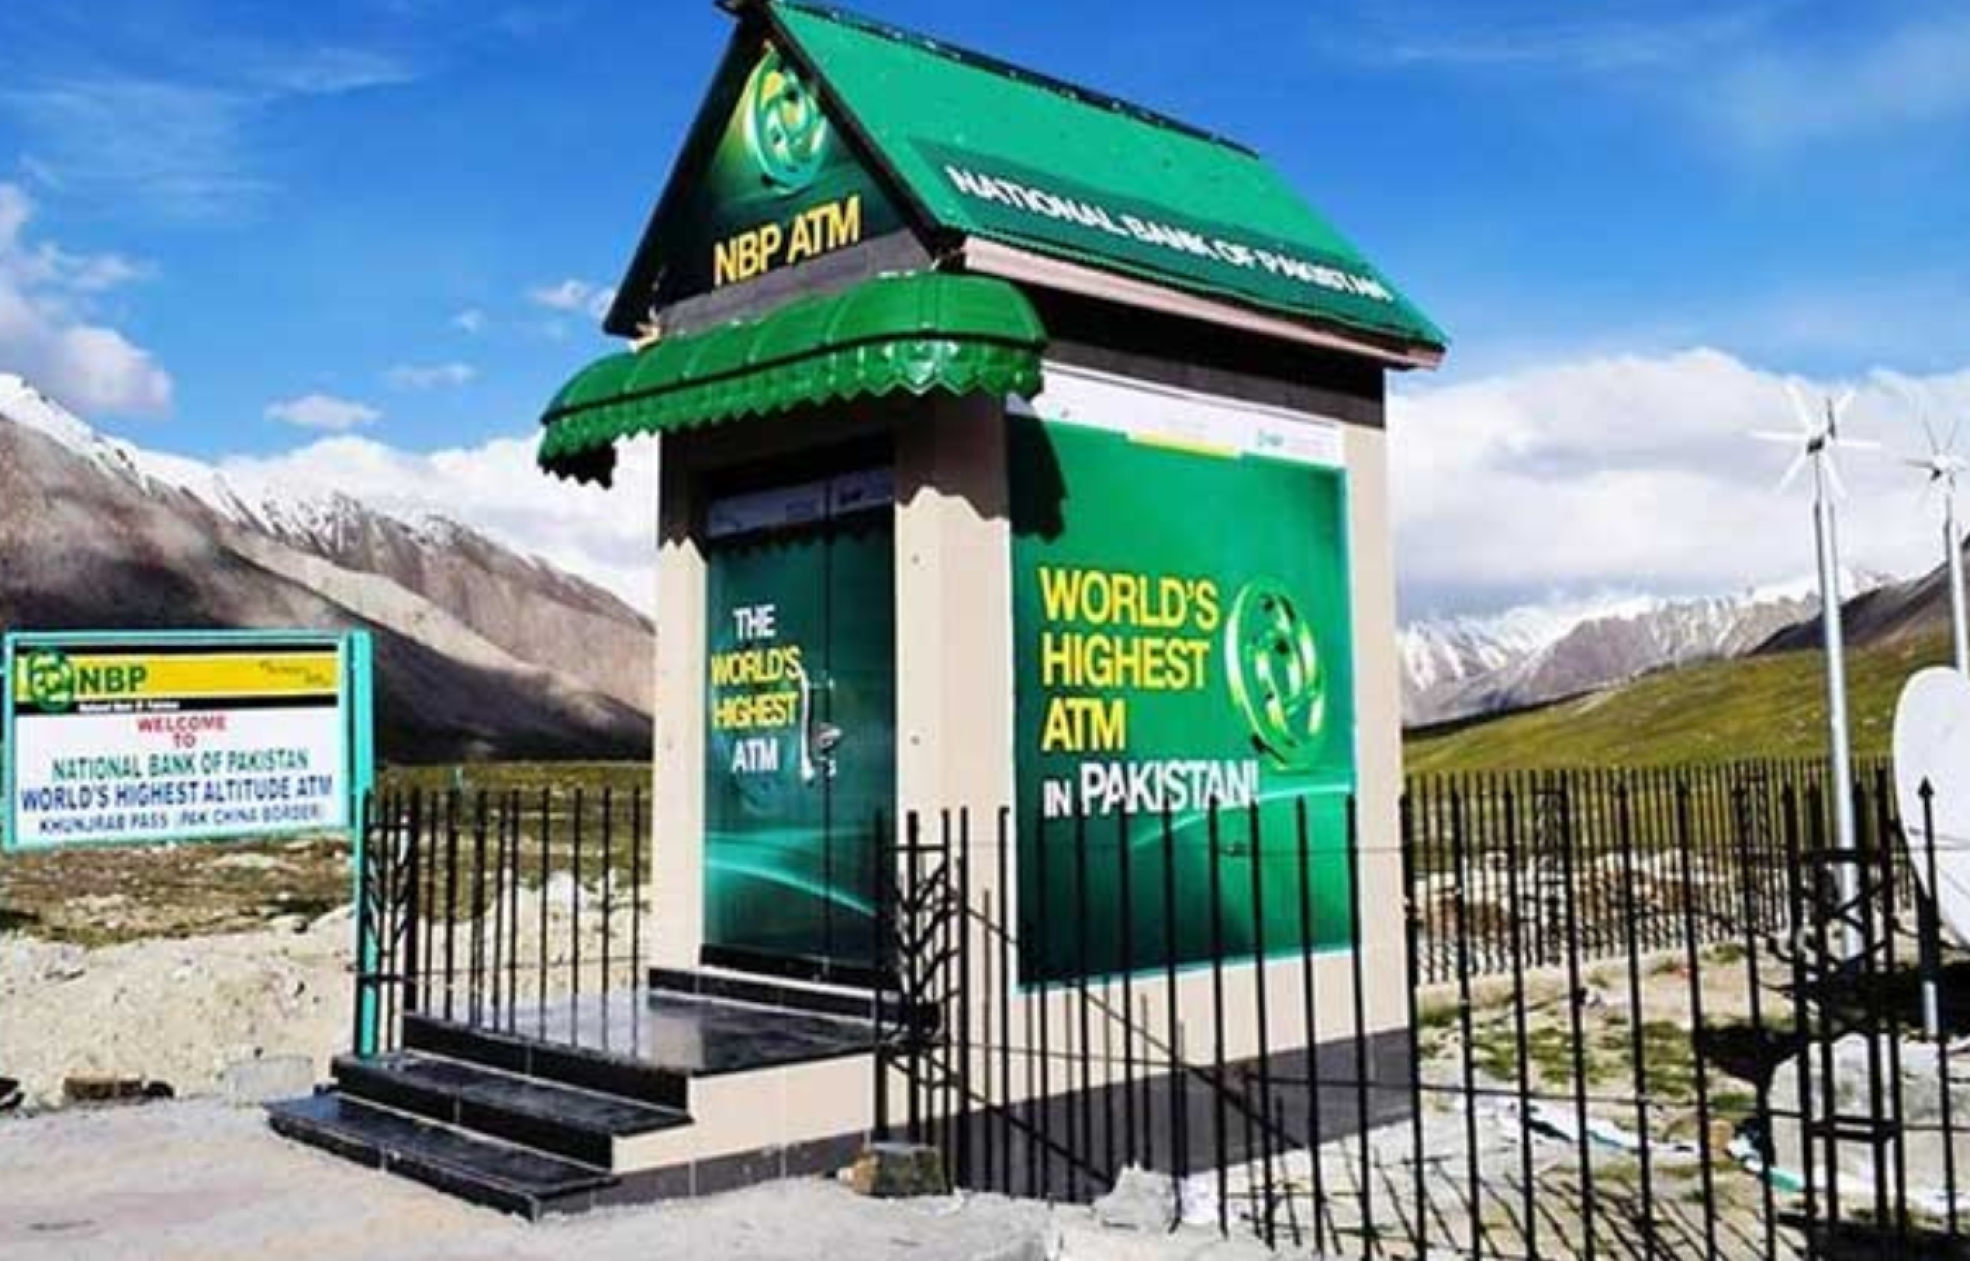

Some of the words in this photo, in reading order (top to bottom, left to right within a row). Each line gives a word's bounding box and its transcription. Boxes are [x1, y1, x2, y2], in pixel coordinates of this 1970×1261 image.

[713, 224, 782, 287] NBP
[787, 195, 861, 264] ATM
[945, 164, 1129, 236] NATIONAL
[1118, 213, 1219, 260] BANK
[1212, 239, 1255, 269] OF
[1253, 249, 1393, 302] PAKISTAN
[1040, 567, 1220, 629] WORLD'S
[733, 605, 777, 639] THE
[711, 646, 803, 686] WORLD'S
[1042, 633, 1210, 689] HIGHEST
[79, 666, 147, 694] NBP
[138, 716, 226, 732] WELCOME
[713, 691, 800, 729] HIGHEST
[1042, 698, 1126, 751] ATM
[174, 734, 196, 748] TO
[733, 739, 779, 773] ATM
[52, 757, 141, 781] NATIONAL
[149, 753, 196, 776] BANK
[201, 752, 221, 774] OF
[228, 749, 309, 773] PAKISTAN
[22, 784, 109, 811] WORLD'S
[115, 781, 198, 806] HIGHEST
[203, 776, 289, 802] ALTITUDE
[297, 774, 332, 797] ATM
[1043, 780, 1073, 817] IN
[130, 811, 168, 830] PASS
